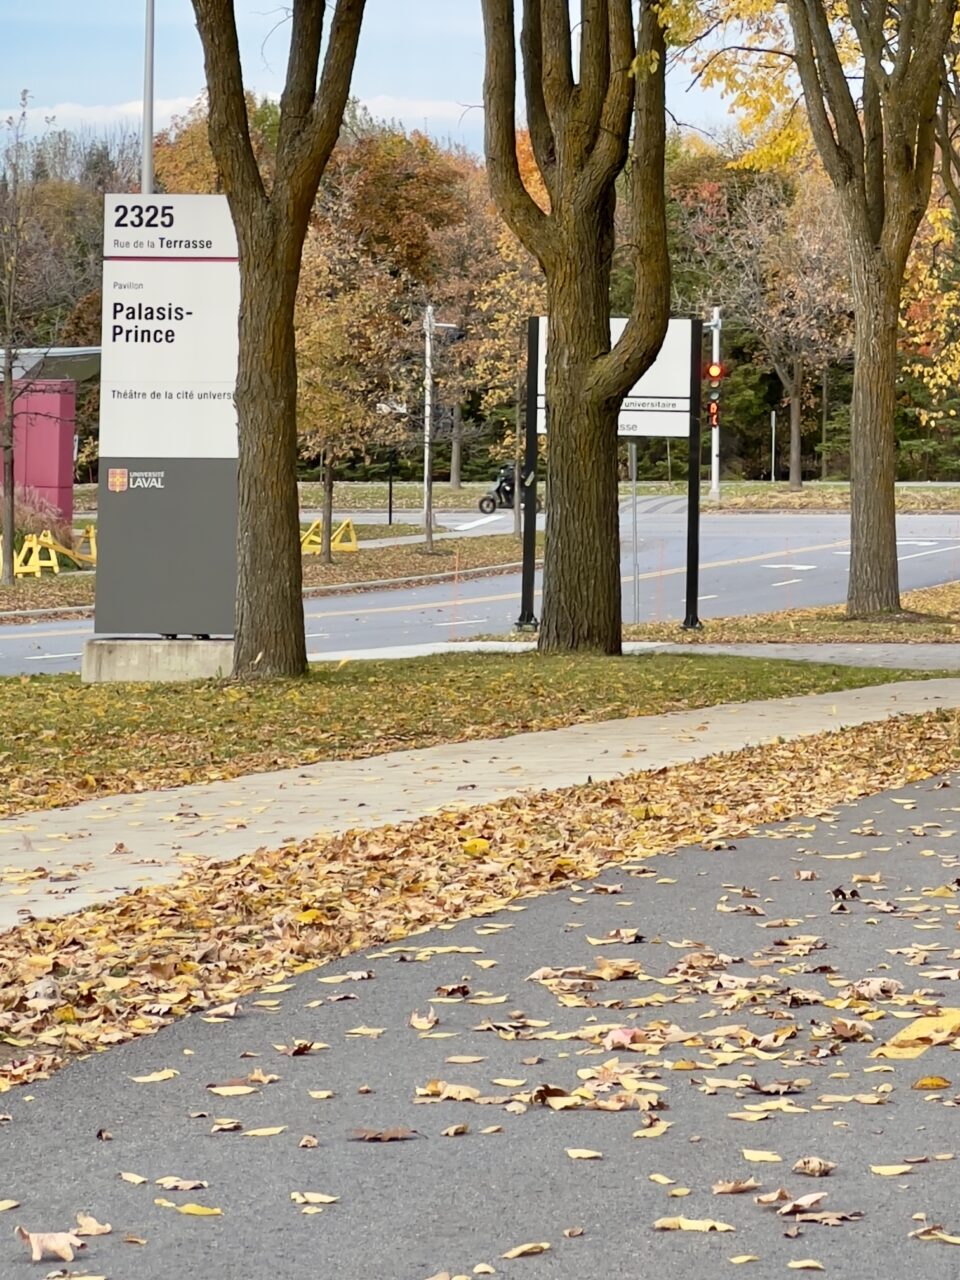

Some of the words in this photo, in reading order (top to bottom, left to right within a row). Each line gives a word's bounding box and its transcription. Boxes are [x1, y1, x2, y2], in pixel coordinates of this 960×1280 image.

[114, 205, 174, 228] 2325
[113, 239, 130, 249] Rue
[133, 239, 144, 249] de
[147, 239, 155, 249] la
[158, 237, 213, 249] Terrasse
[113, 281, 144, 290] Pavillon
[112, 302, 193, 321] Palasis-
[112, 324, 175, 343] Prince
[111, 389, 147, 400] Théâtre
[150, 391, 161, 400] de
[164, 391, 173, 400] la
[176, 390, 194, 400] cité
[624, 401, 677, 409] universitaire
[129, 478, 165, 489] LAVAL
